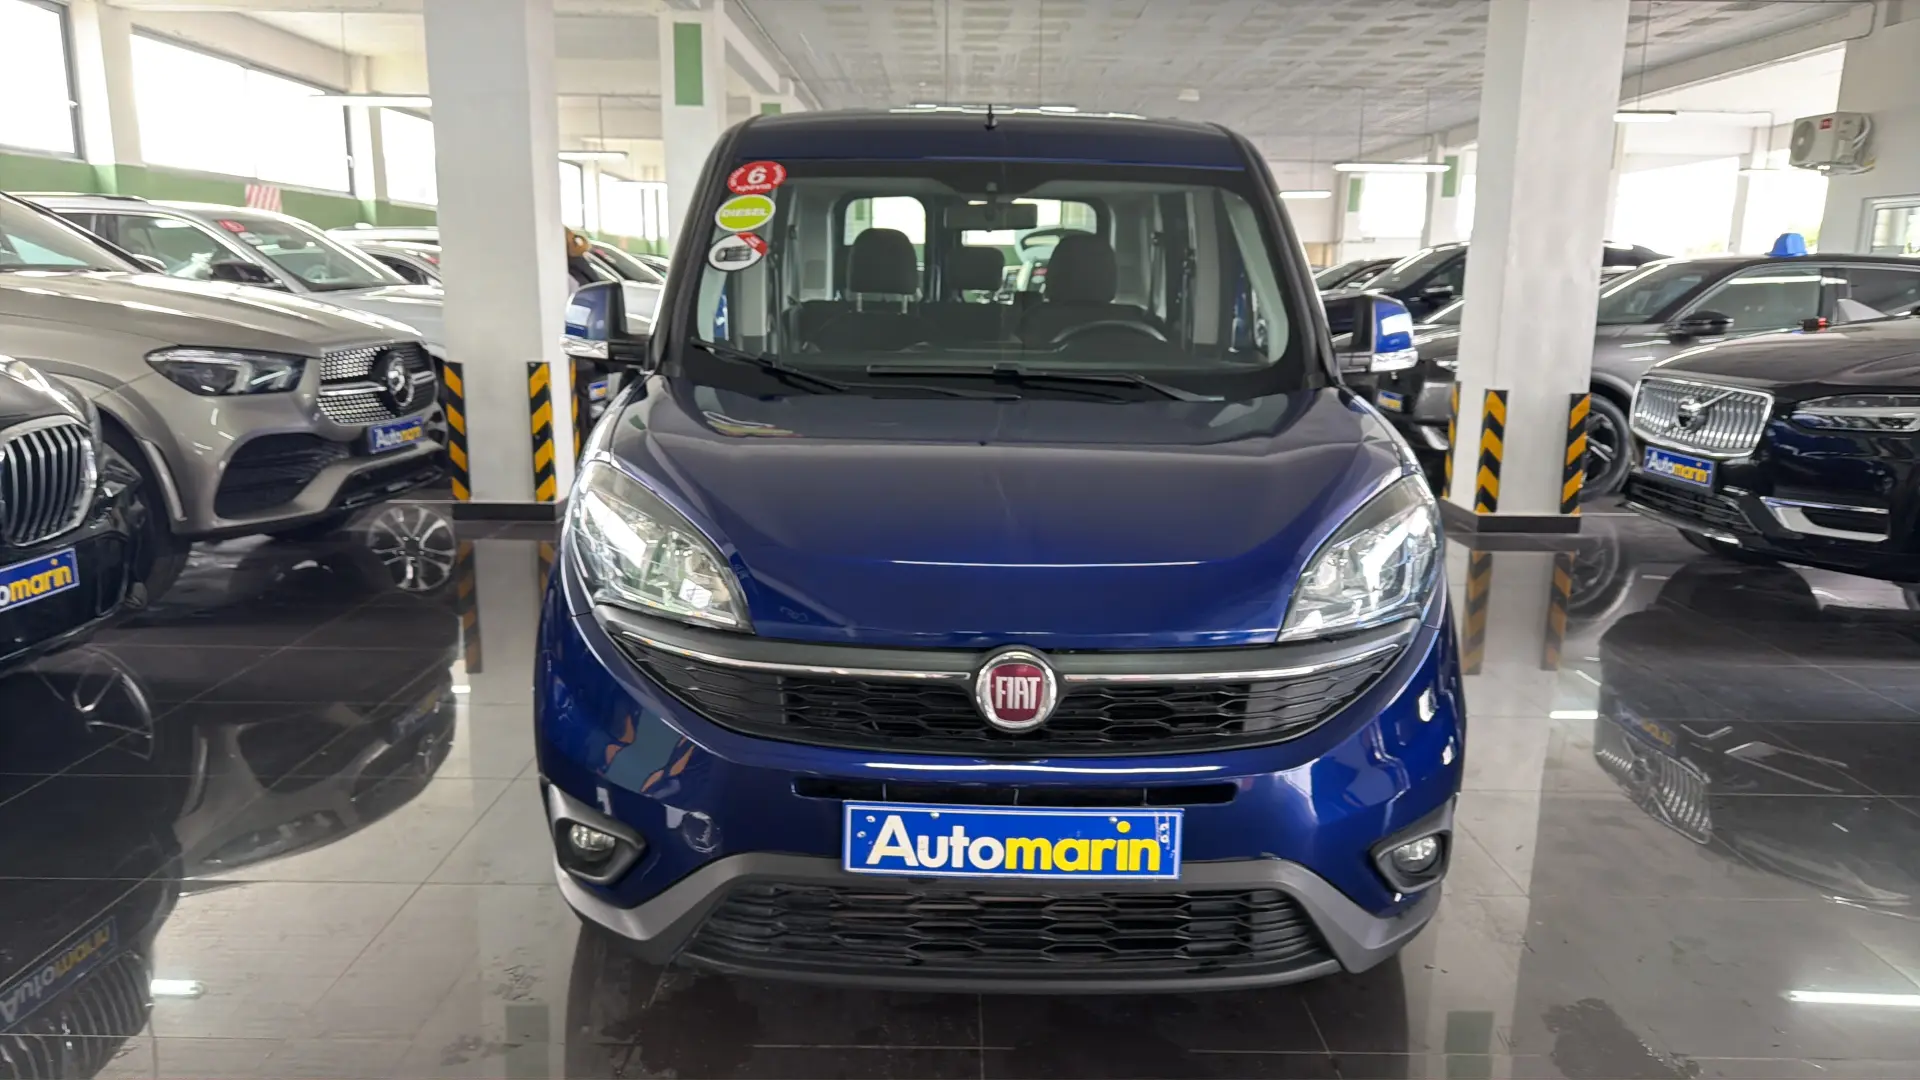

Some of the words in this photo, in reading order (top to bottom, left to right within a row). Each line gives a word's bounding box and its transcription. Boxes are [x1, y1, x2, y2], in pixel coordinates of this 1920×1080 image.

[748, 166, 767, 184] 6
[721, 208, 768, 217] DIESEL
[1647, 450, 1708, 483] Automarin
[996, 676, 1041, 710] FIAT
[866, 814, 1161, 872] Automarin
